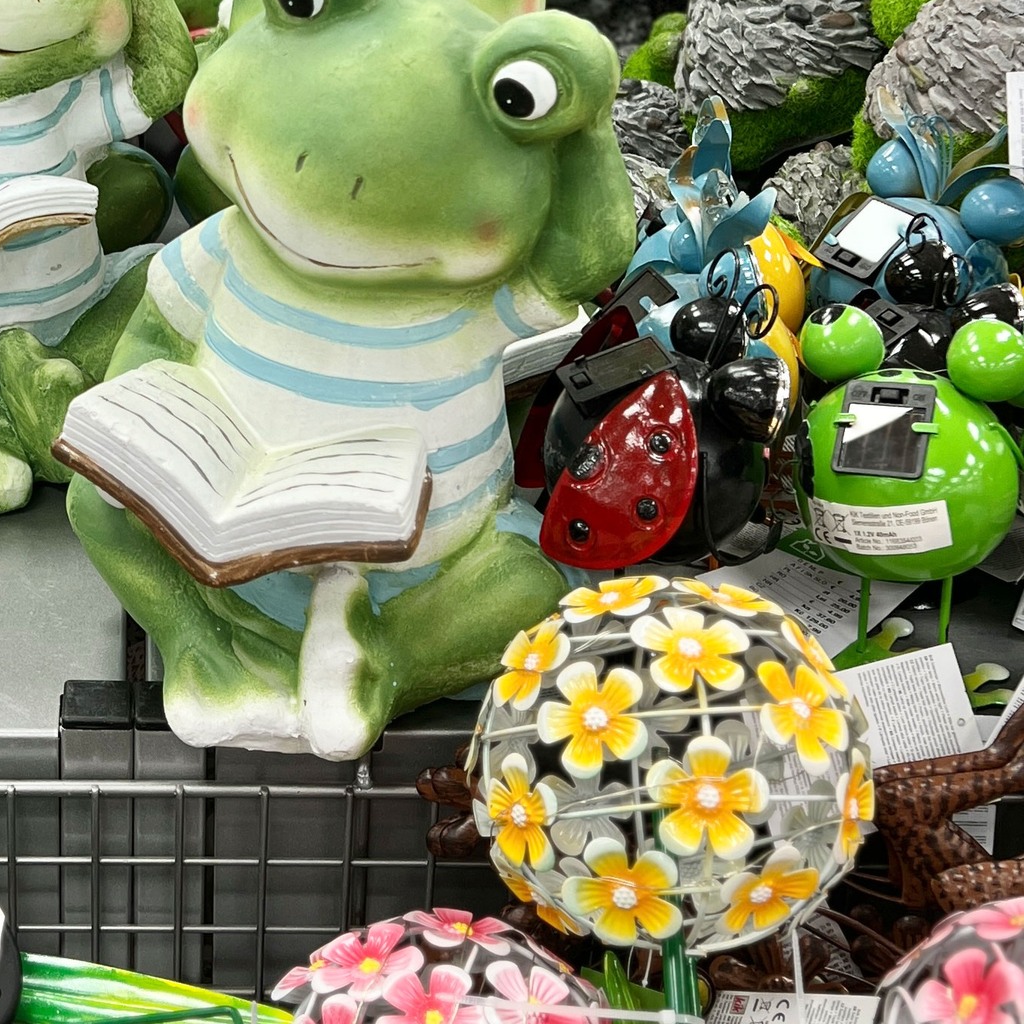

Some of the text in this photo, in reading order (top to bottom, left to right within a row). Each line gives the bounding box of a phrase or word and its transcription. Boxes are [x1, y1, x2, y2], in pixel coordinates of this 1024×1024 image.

[892, 510, 919, 518] Non-Food
[920, 508, 937, 516] GmbH
[830, 603, 850, 613] 25.00
[838, 598, 857, 608] 20.00
[827, 610, 844, 619] 4.99
